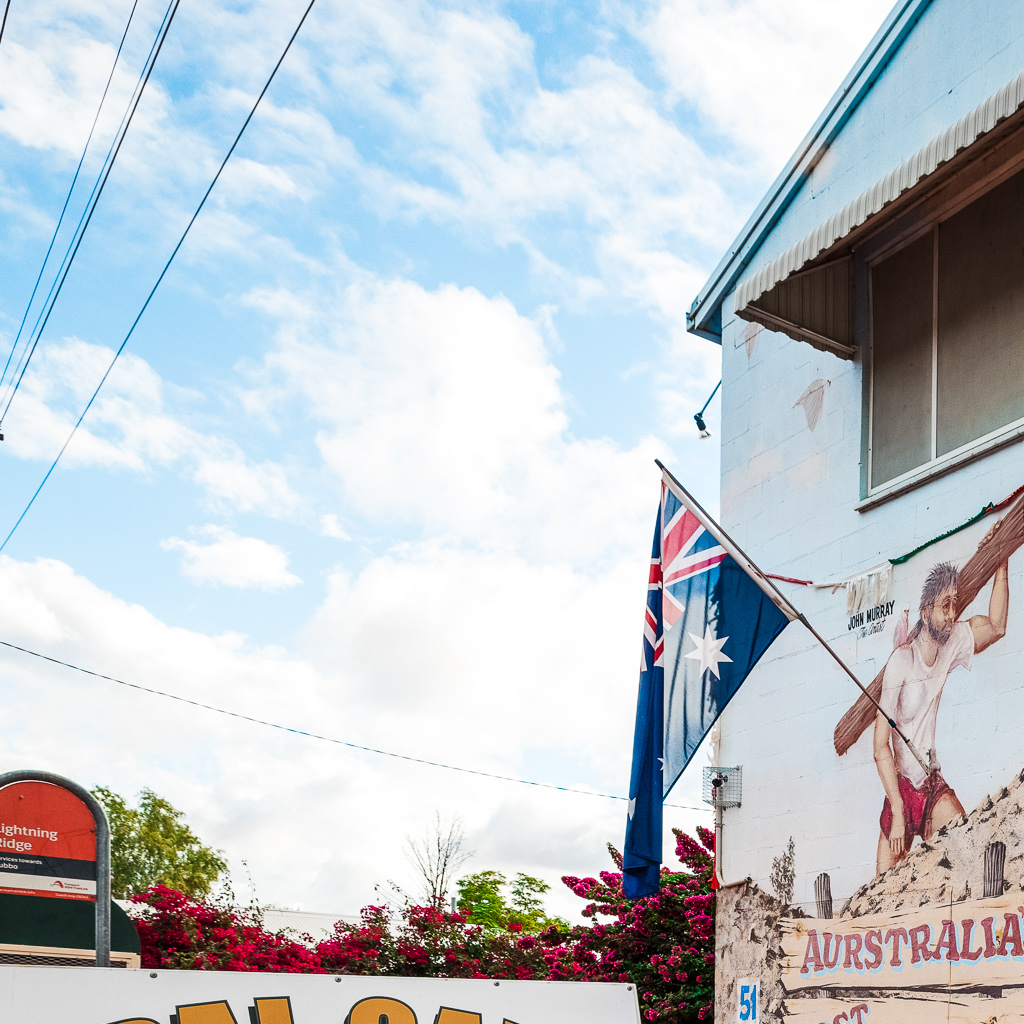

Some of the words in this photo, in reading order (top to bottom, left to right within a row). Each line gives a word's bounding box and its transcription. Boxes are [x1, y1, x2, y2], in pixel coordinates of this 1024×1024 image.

[847, 611, 864, 631] JOHN
[866, 599, 896, 624] MURRAY
[0, 822, 58, 842] ightning
[0, 862, 19, 870] ubbo
[739, 984, 757, 1021] 51
